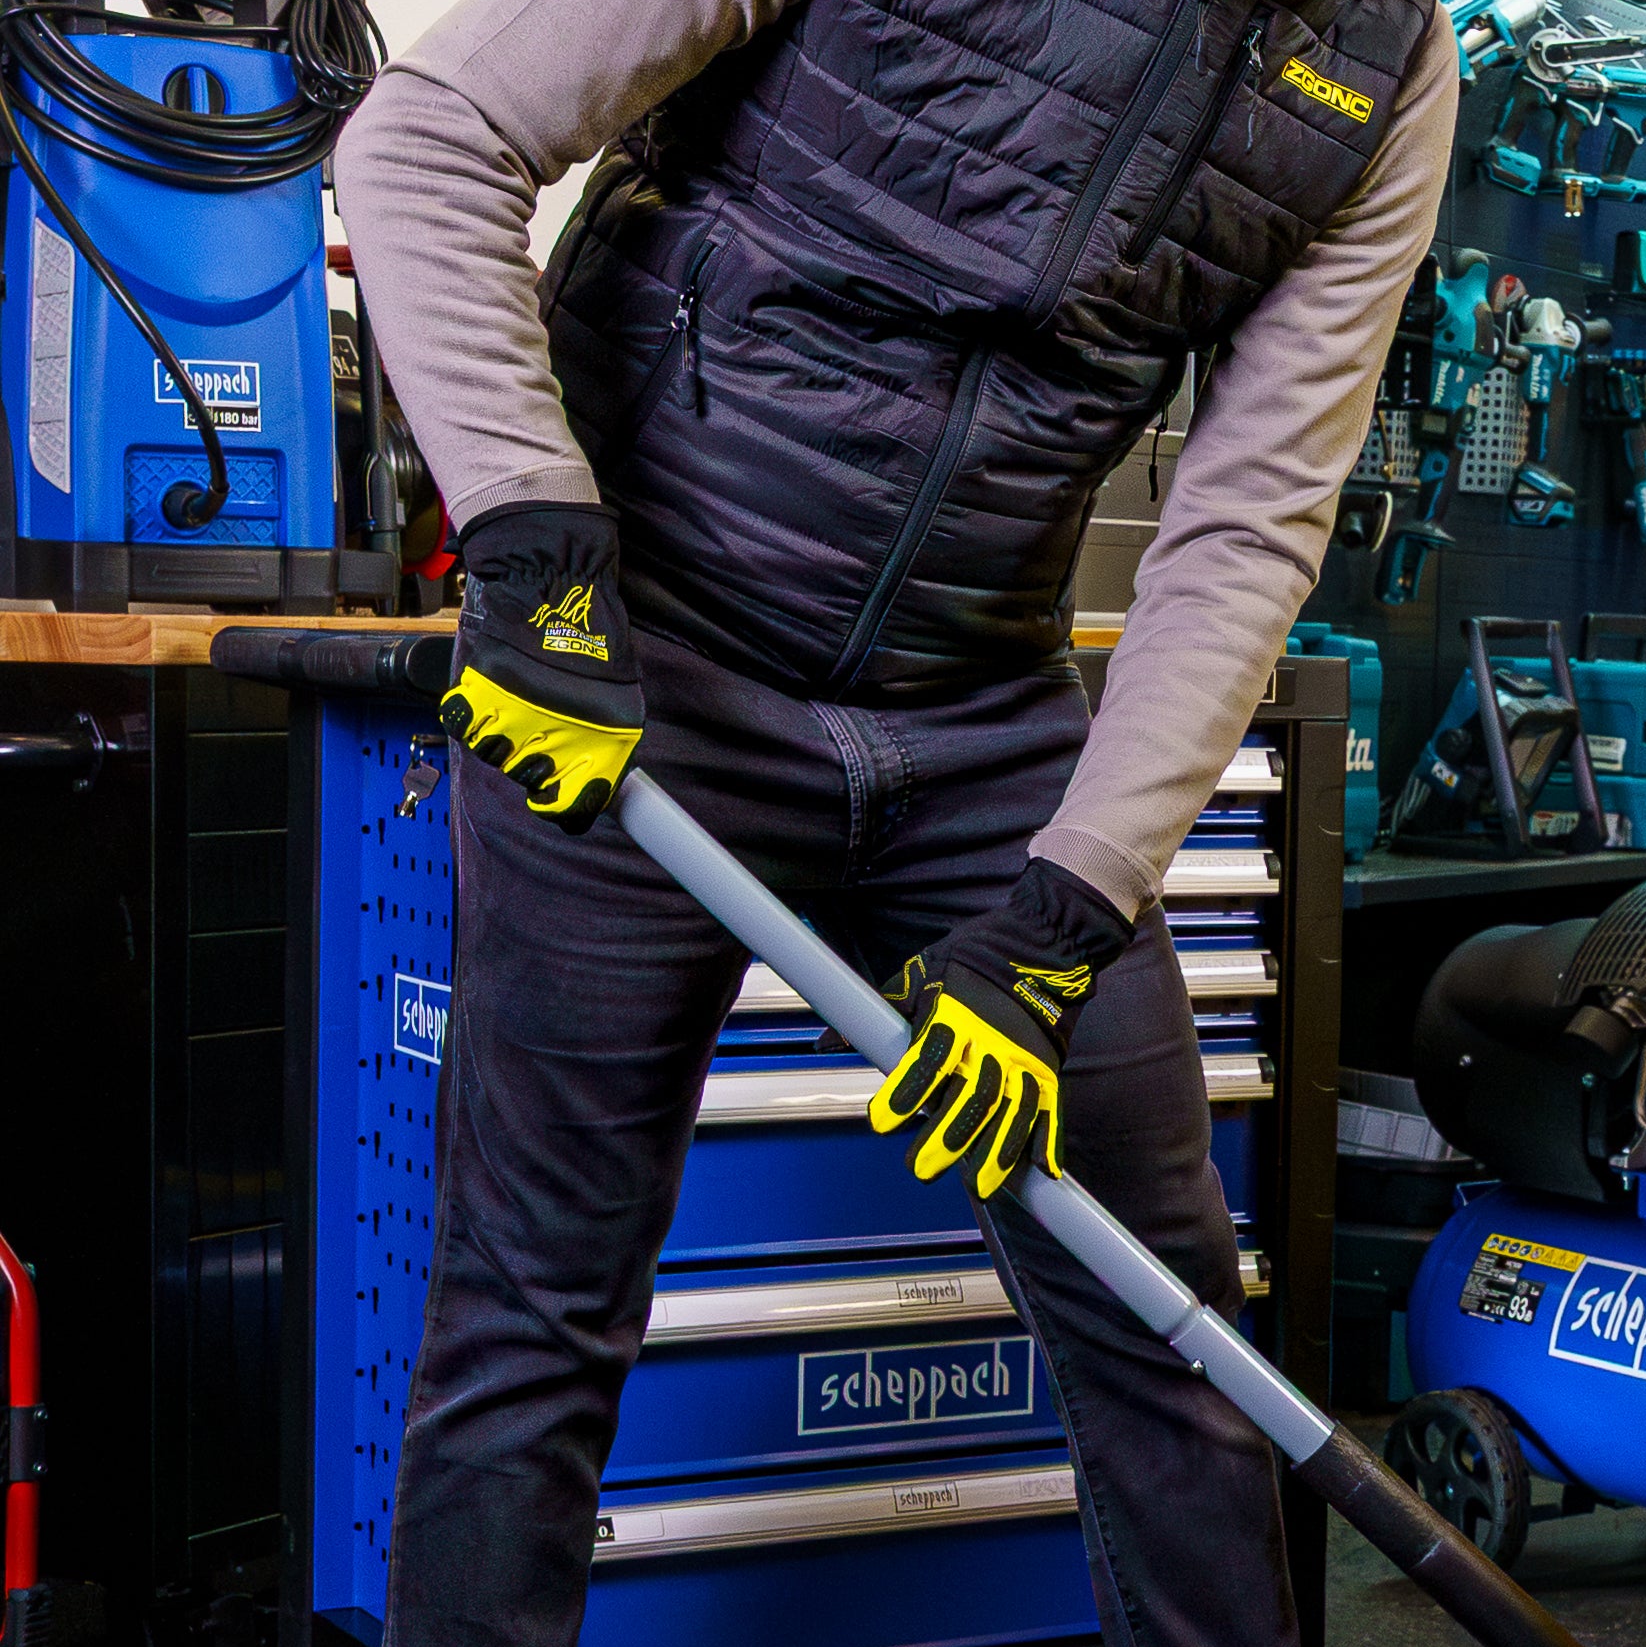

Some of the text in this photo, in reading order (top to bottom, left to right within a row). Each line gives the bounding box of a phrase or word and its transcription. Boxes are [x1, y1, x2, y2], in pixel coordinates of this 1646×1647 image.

[1286, 60, 1370, 118] ZGONC
[165, 363, 250, 402] seppach
[242, 414, 258, 426] bar
[545, 628, 578, 637] LIMITED
[545, 638, 606, 658] ZGONC
[904, 1280, 958, 1304] scheppach
[1508, 1296, 1528, 1320] 93
[822, 1342, 1009, 1422] scheppach
[900, 1484, 953, 1510] scheppach
